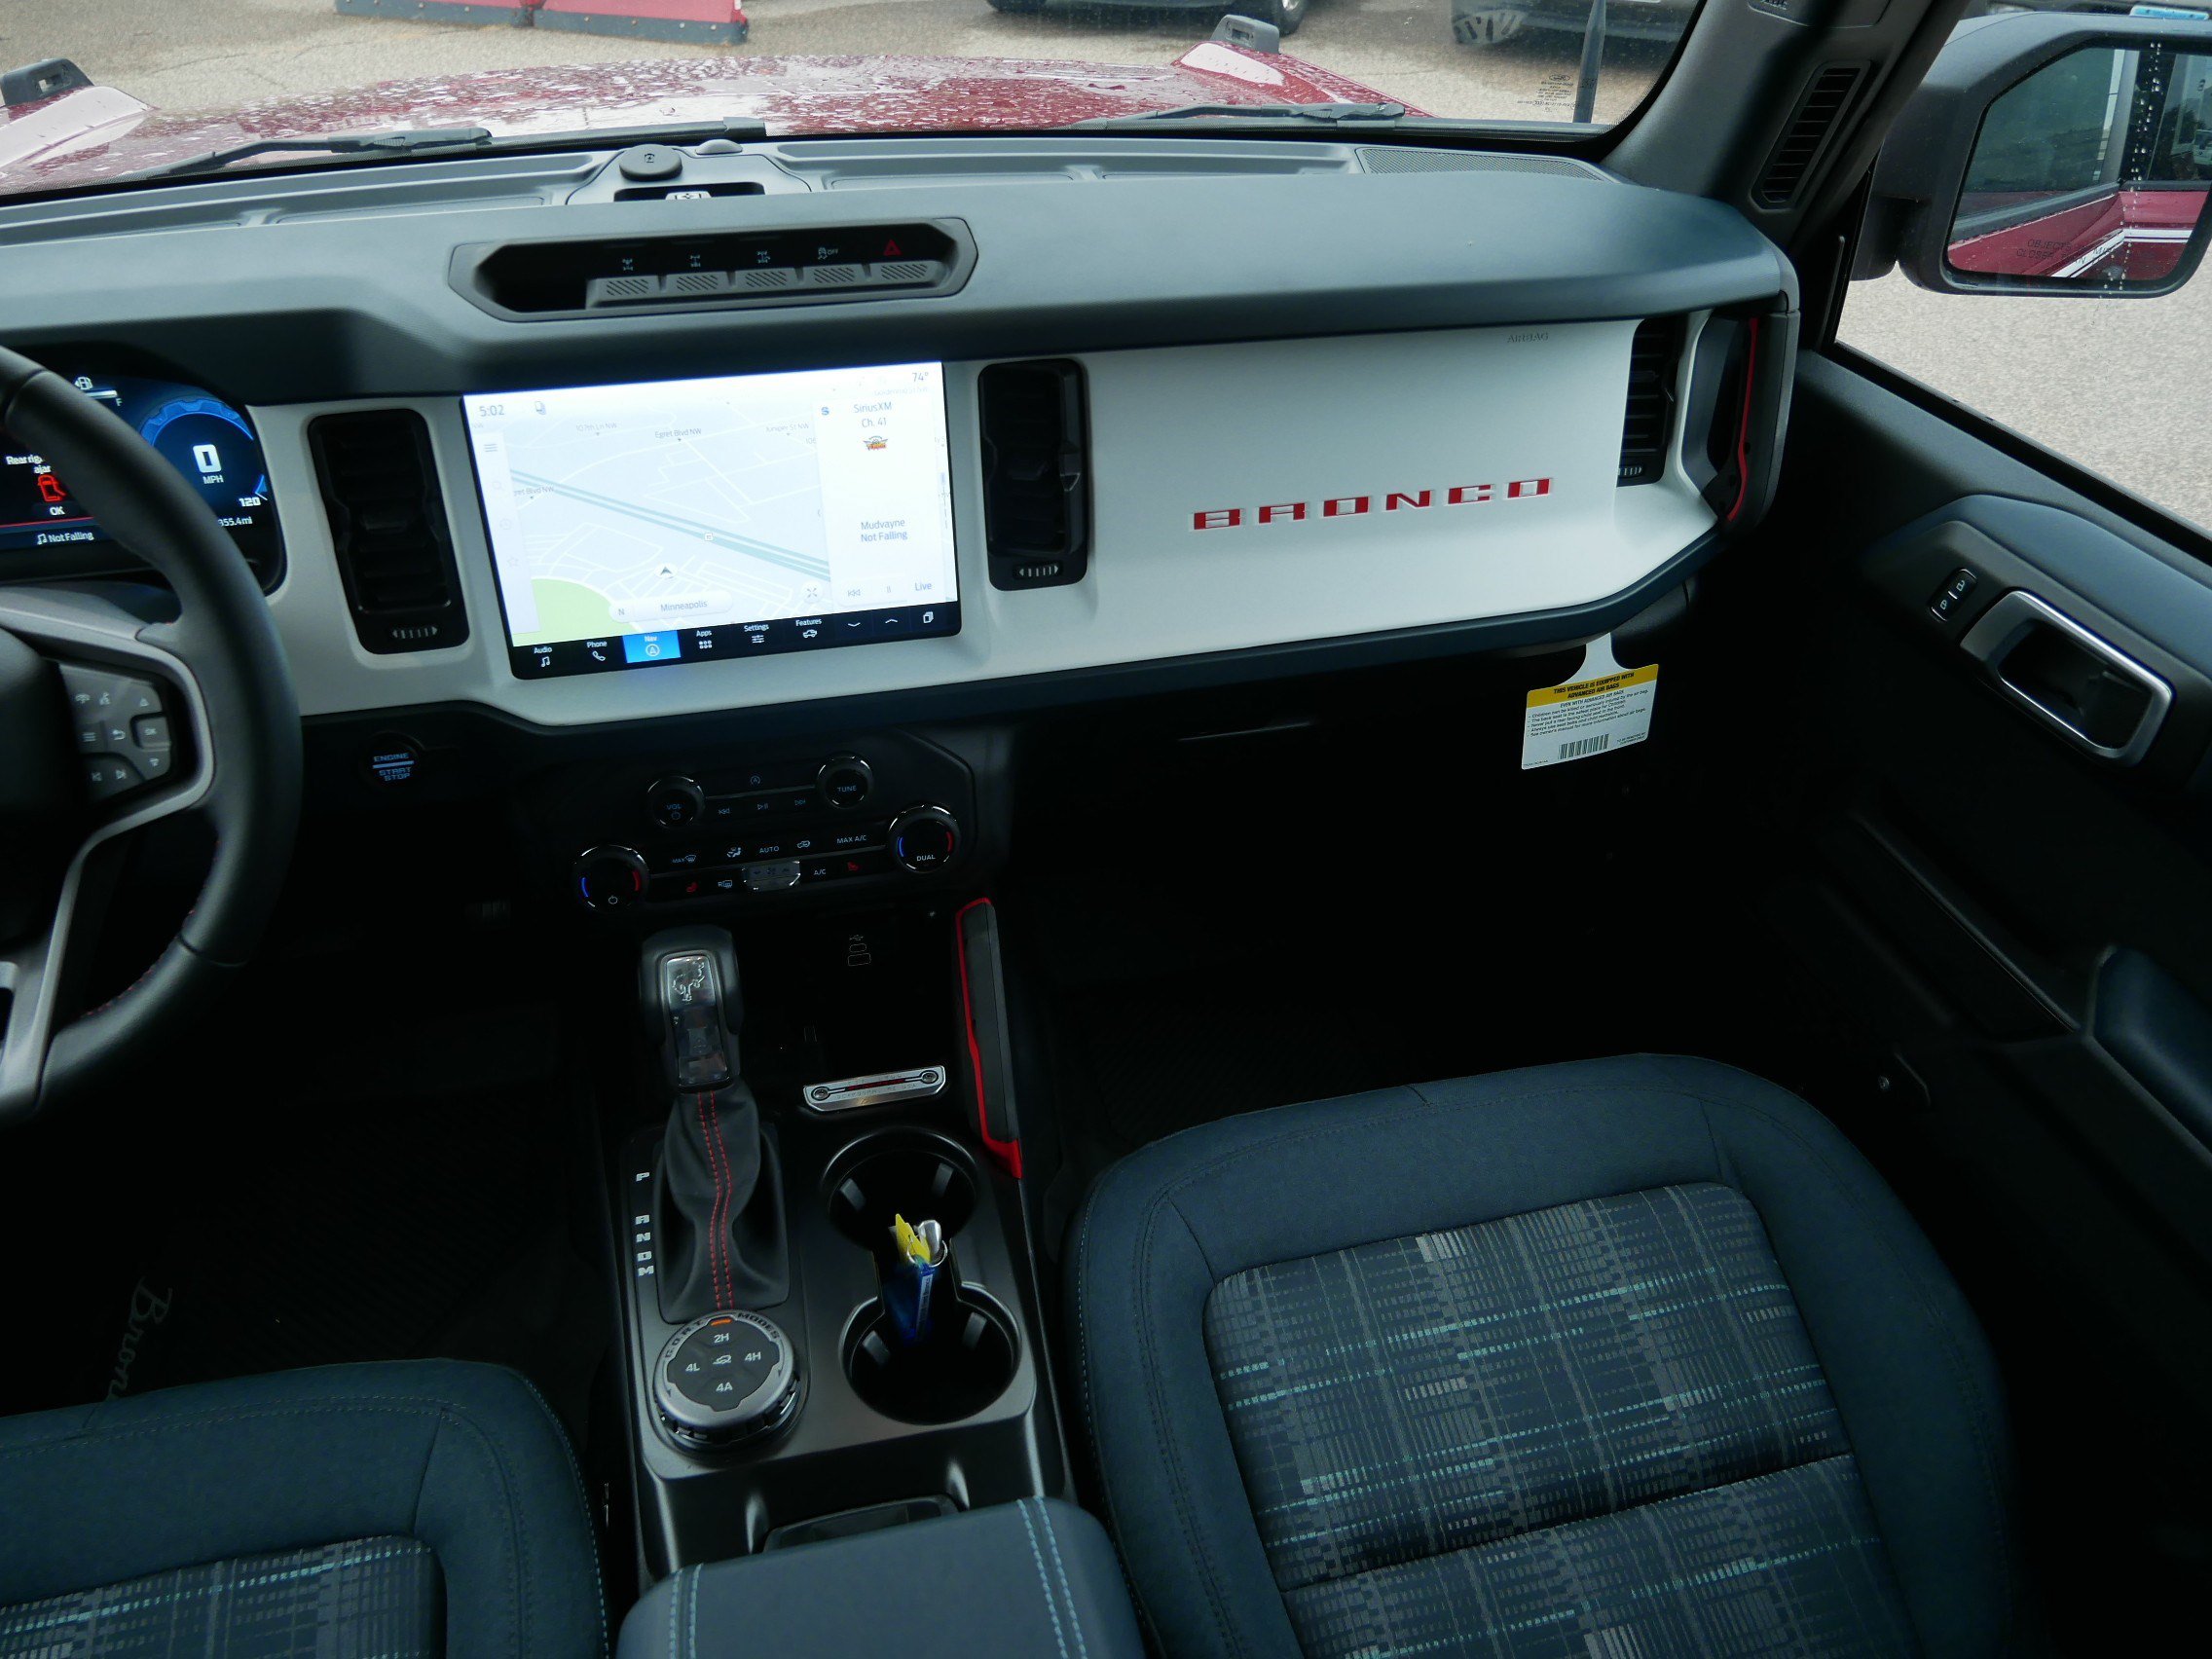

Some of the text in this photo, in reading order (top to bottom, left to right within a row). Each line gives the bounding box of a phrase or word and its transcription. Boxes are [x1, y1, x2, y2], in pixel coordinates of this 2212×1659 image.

[2028, 239, 2072, 250] OBJECTS
[2016, 248, 2054, 259] CLOSER
[1507, 332, 1550, 344] AIRBAG
[115, 397, 123, 407] F
[854, 401, 892, 414] SiriusXM
[479, 405, 505, 417] 5:02
[862, 417, 887, 428] Ch. 41
[654, 430, 672, 439] Egret
[673, 428, 688, 437] Blvd
[6, 456, 27, 465] Rear
[193, 444, 222, 473] 0
[34, 464, 52, 474] ajar
[203, 475, 224, 485] MPH
[239, 497, 261, 507] 120
[1192, 477, 1552, 532] BRONCO
[50, 506, 65, 516] OK
[861, 519, 905, 531] Mudvayne
[49, 531, 94, 542] Not Falling
[861, 531, 908, 542] Not Falling
[914, 581, 933, 592] Live
[660, 598, 708, 613] Minneapolis
[618, 608, 625, 616] N
[744, 622, 770, 634] Settings
[795, 617, 823, 628] Features
[696, 629, 712, 639] Apps
[534, 645, 553, 655] Audio
[587, 640, 608, 649] Phone
[1596, 676, 1621, 686] EQUIPPED
[1567, 689, 1596, 698] ADVANCED
[373, 753, 410, 762] ENGINE
[379, 766, 412, 776] START
[384, 772, 411, 782] STOP
[837, 785, 858, 793] TUNE
[836, 834, 867, 845] MAX A/C
[916, 853, 936, 862] DUAL
[636, 1171, 650, 1182] P
[636, 1214, 649, 1225] R
[636, 1232, 651, 1242] N
[637, 1251, 652, 1261] D
[638, 1265, 654, 1276] M
[738, 1312, 781, 1340] MODES
[107, 1275, 173, 1402] Bron
[714, 1333, 730, 1344] 2H
[744, 1351, 761, 1362] 4H
[685, 1363, 700, 1373] 4L
[716, 1382, 733, 1392] 4A
